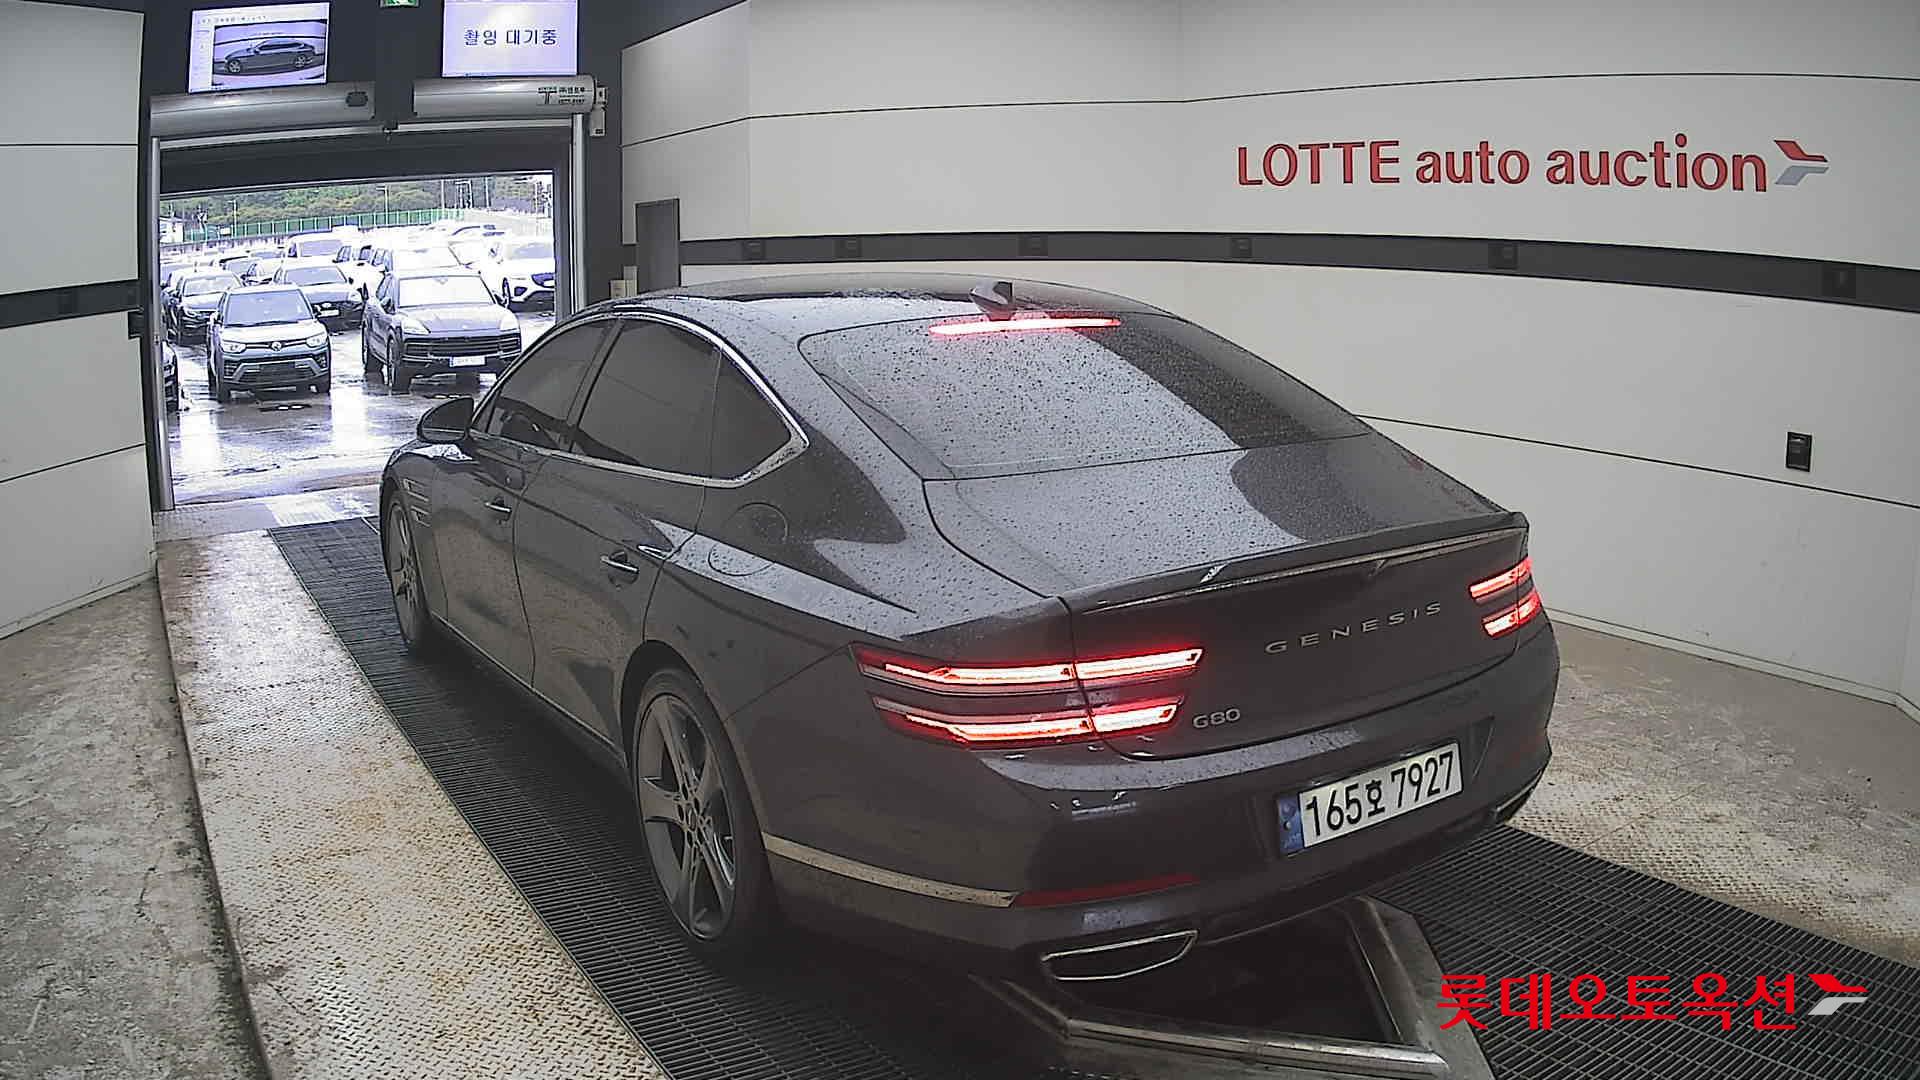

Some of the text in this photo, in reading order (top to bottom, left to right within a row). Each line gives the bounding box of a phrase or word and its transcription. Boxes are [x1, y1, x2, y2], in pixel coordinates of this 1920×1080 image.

[505, 29, 557, 46] 대기중
[1238, 133, 1767, 193] LOTTE auto auction
[1264, 601, 1442, 654] GENESIS
[1192, 708, 1241, 729] G80
[1305, 750, 1454, 837] 165호 7927
